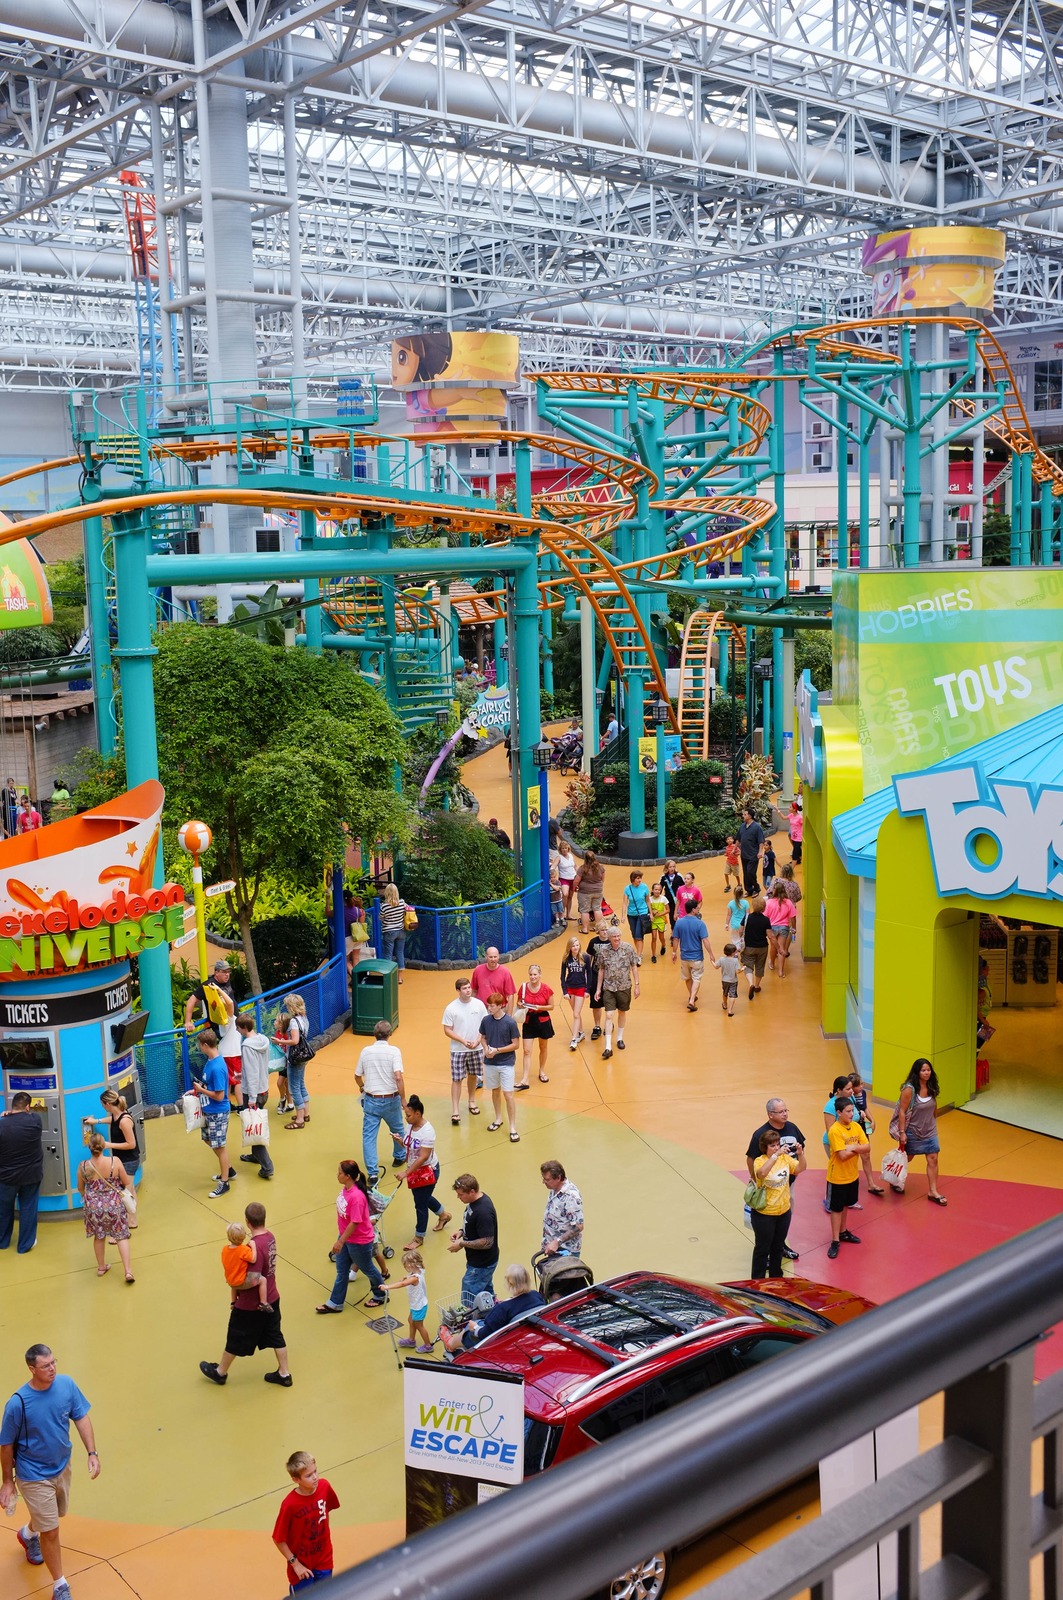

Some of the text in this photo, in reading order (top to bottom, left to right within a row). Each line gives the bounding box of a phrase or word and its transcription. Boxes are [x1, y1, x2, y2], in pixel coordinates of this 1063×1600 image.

[4, 596, 29, 612] TASHA
[859, 588, 974, 641] HOBBIES
[933, 655, 1035, 719] TOYS
[477, 700, 504, 715] FAIRLY
[105, 983, 129, 1011] TICKETS
[5, 1003, 49, 1024] TICKETS
[439, 1398, 477, 1411] Enter to
[420, 1403, 472, 1433] Win
[410, 1428, 518, 1464] ESCAPE
[408, 1448, 421, 1456] Drive
[495, 1463, 514, 1471] Escape
